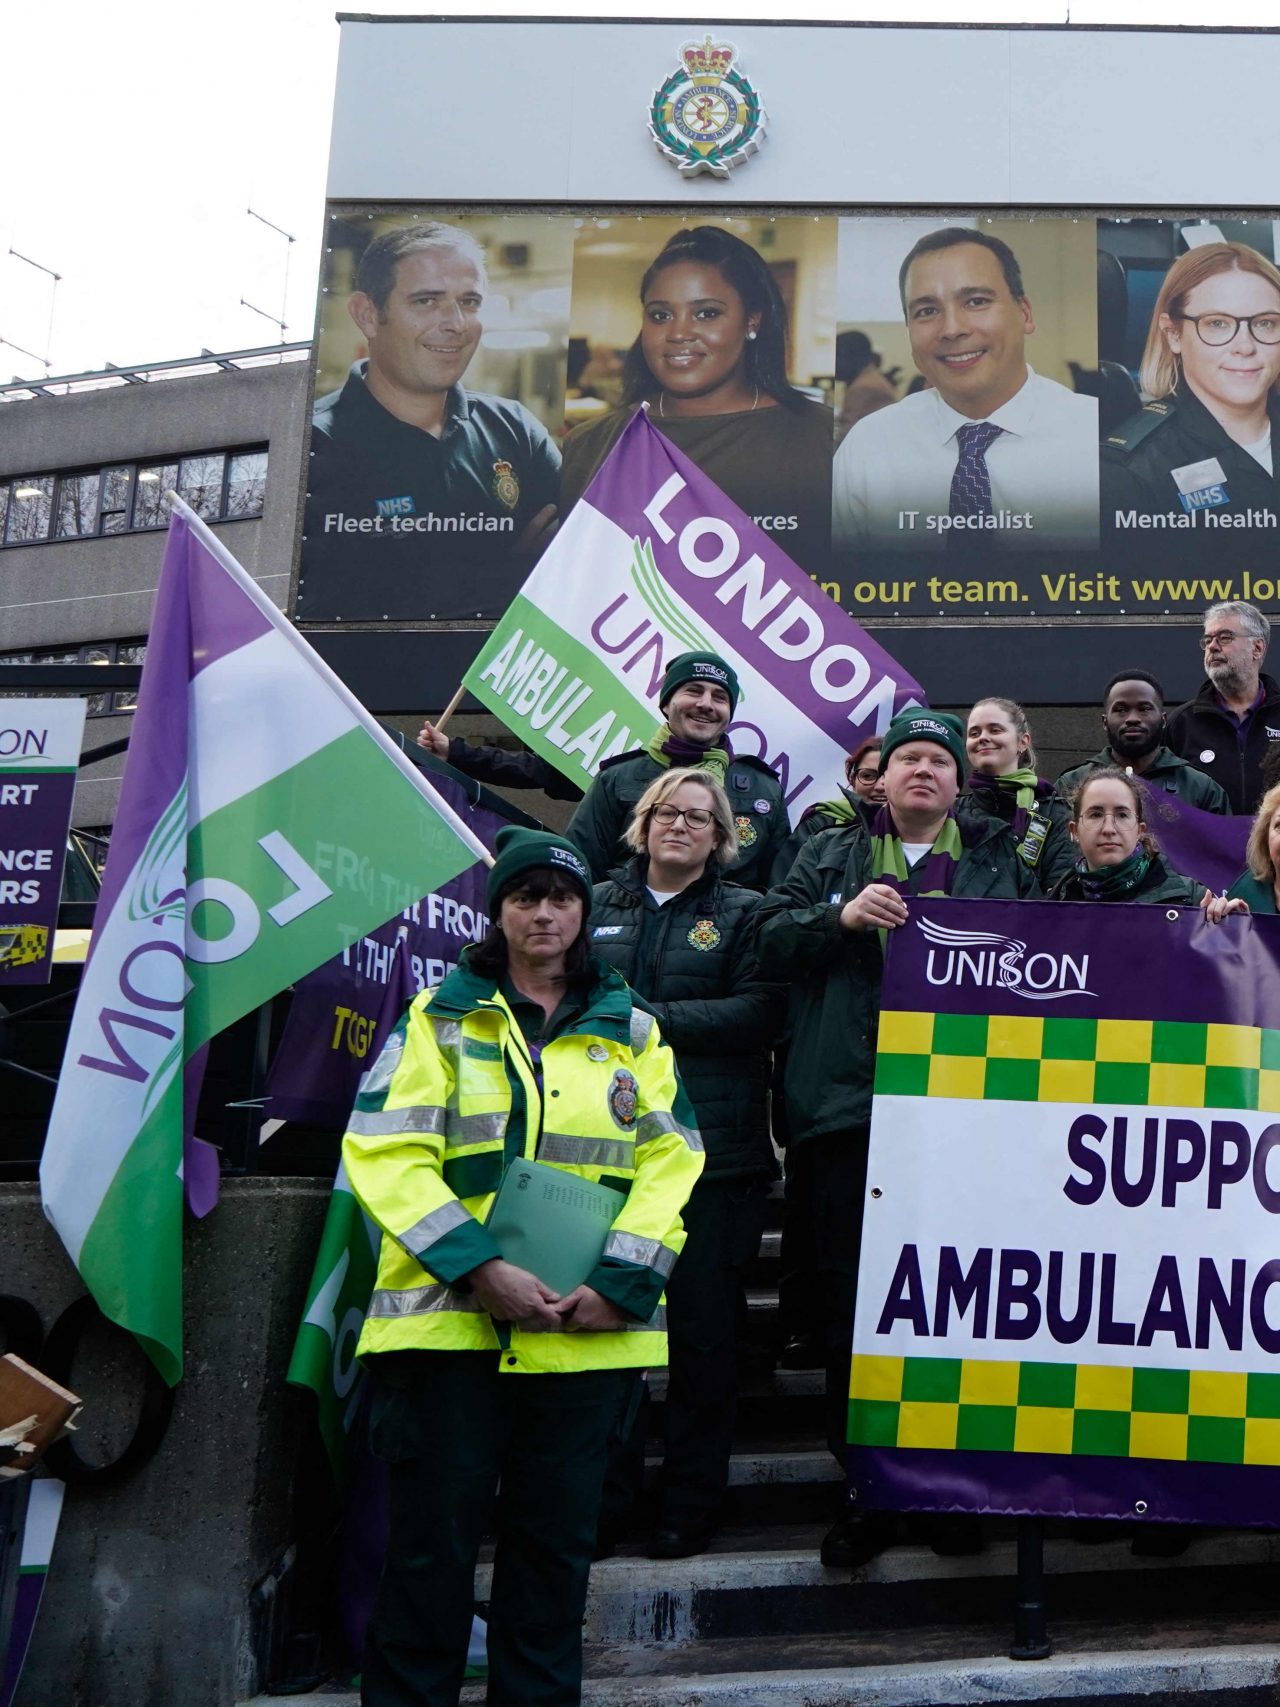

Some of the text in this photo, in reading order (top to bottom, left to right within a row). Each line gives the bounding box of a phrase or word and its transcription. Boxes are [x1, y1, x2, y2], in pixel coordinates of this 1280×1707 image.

[680, 85, 732, 104] AMBULANCE
[377, 497, 414, 516] NHS
[1187, 486, 1224, 510] NHS
[323, 512, 384, 533] Fleet
[391, 511, 514, 532] technician
[899, 509, 1034, 534] IT specialist
[1115, 509, 1197, 528] Mental
[1205, 508, 1277, 528] health
[854, 576, 917, 603] our
[927, 576, 1029, 602] team.
[1041, 573, 1121, 603] Visit
[643, 472, 926, 740] LONDON
[695, 663, 728, 681] UNISON
[591, 592, 815, 806] UNON
[912, 720, 949, 736] UNISON
[0, 729, 47, 755] ON
[593, 925, 624, 938] NHS
[921, 939, 1092, 998] UNISON
